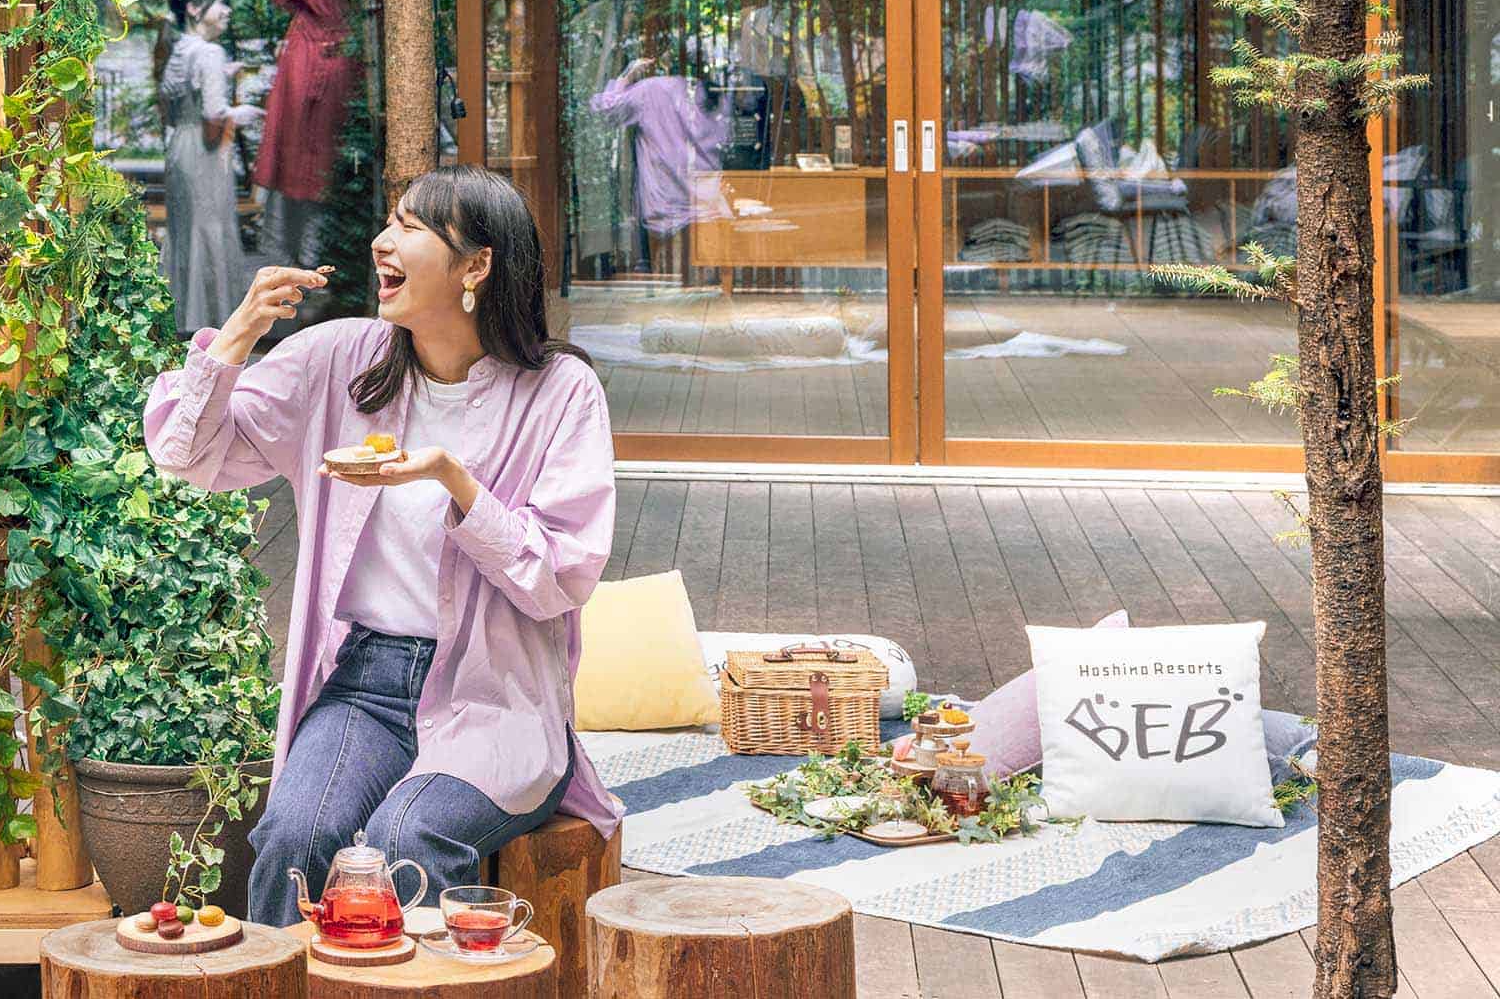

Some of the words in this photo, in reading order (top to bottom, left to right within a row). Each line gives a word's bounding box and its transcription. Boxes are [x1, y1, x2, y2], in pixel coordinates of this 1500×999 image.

[1078, 662, 1149, 677] Hoshino
[1153, 661, 1223, 676] Resorts
[1064, 691, 1234, 763] BEB
